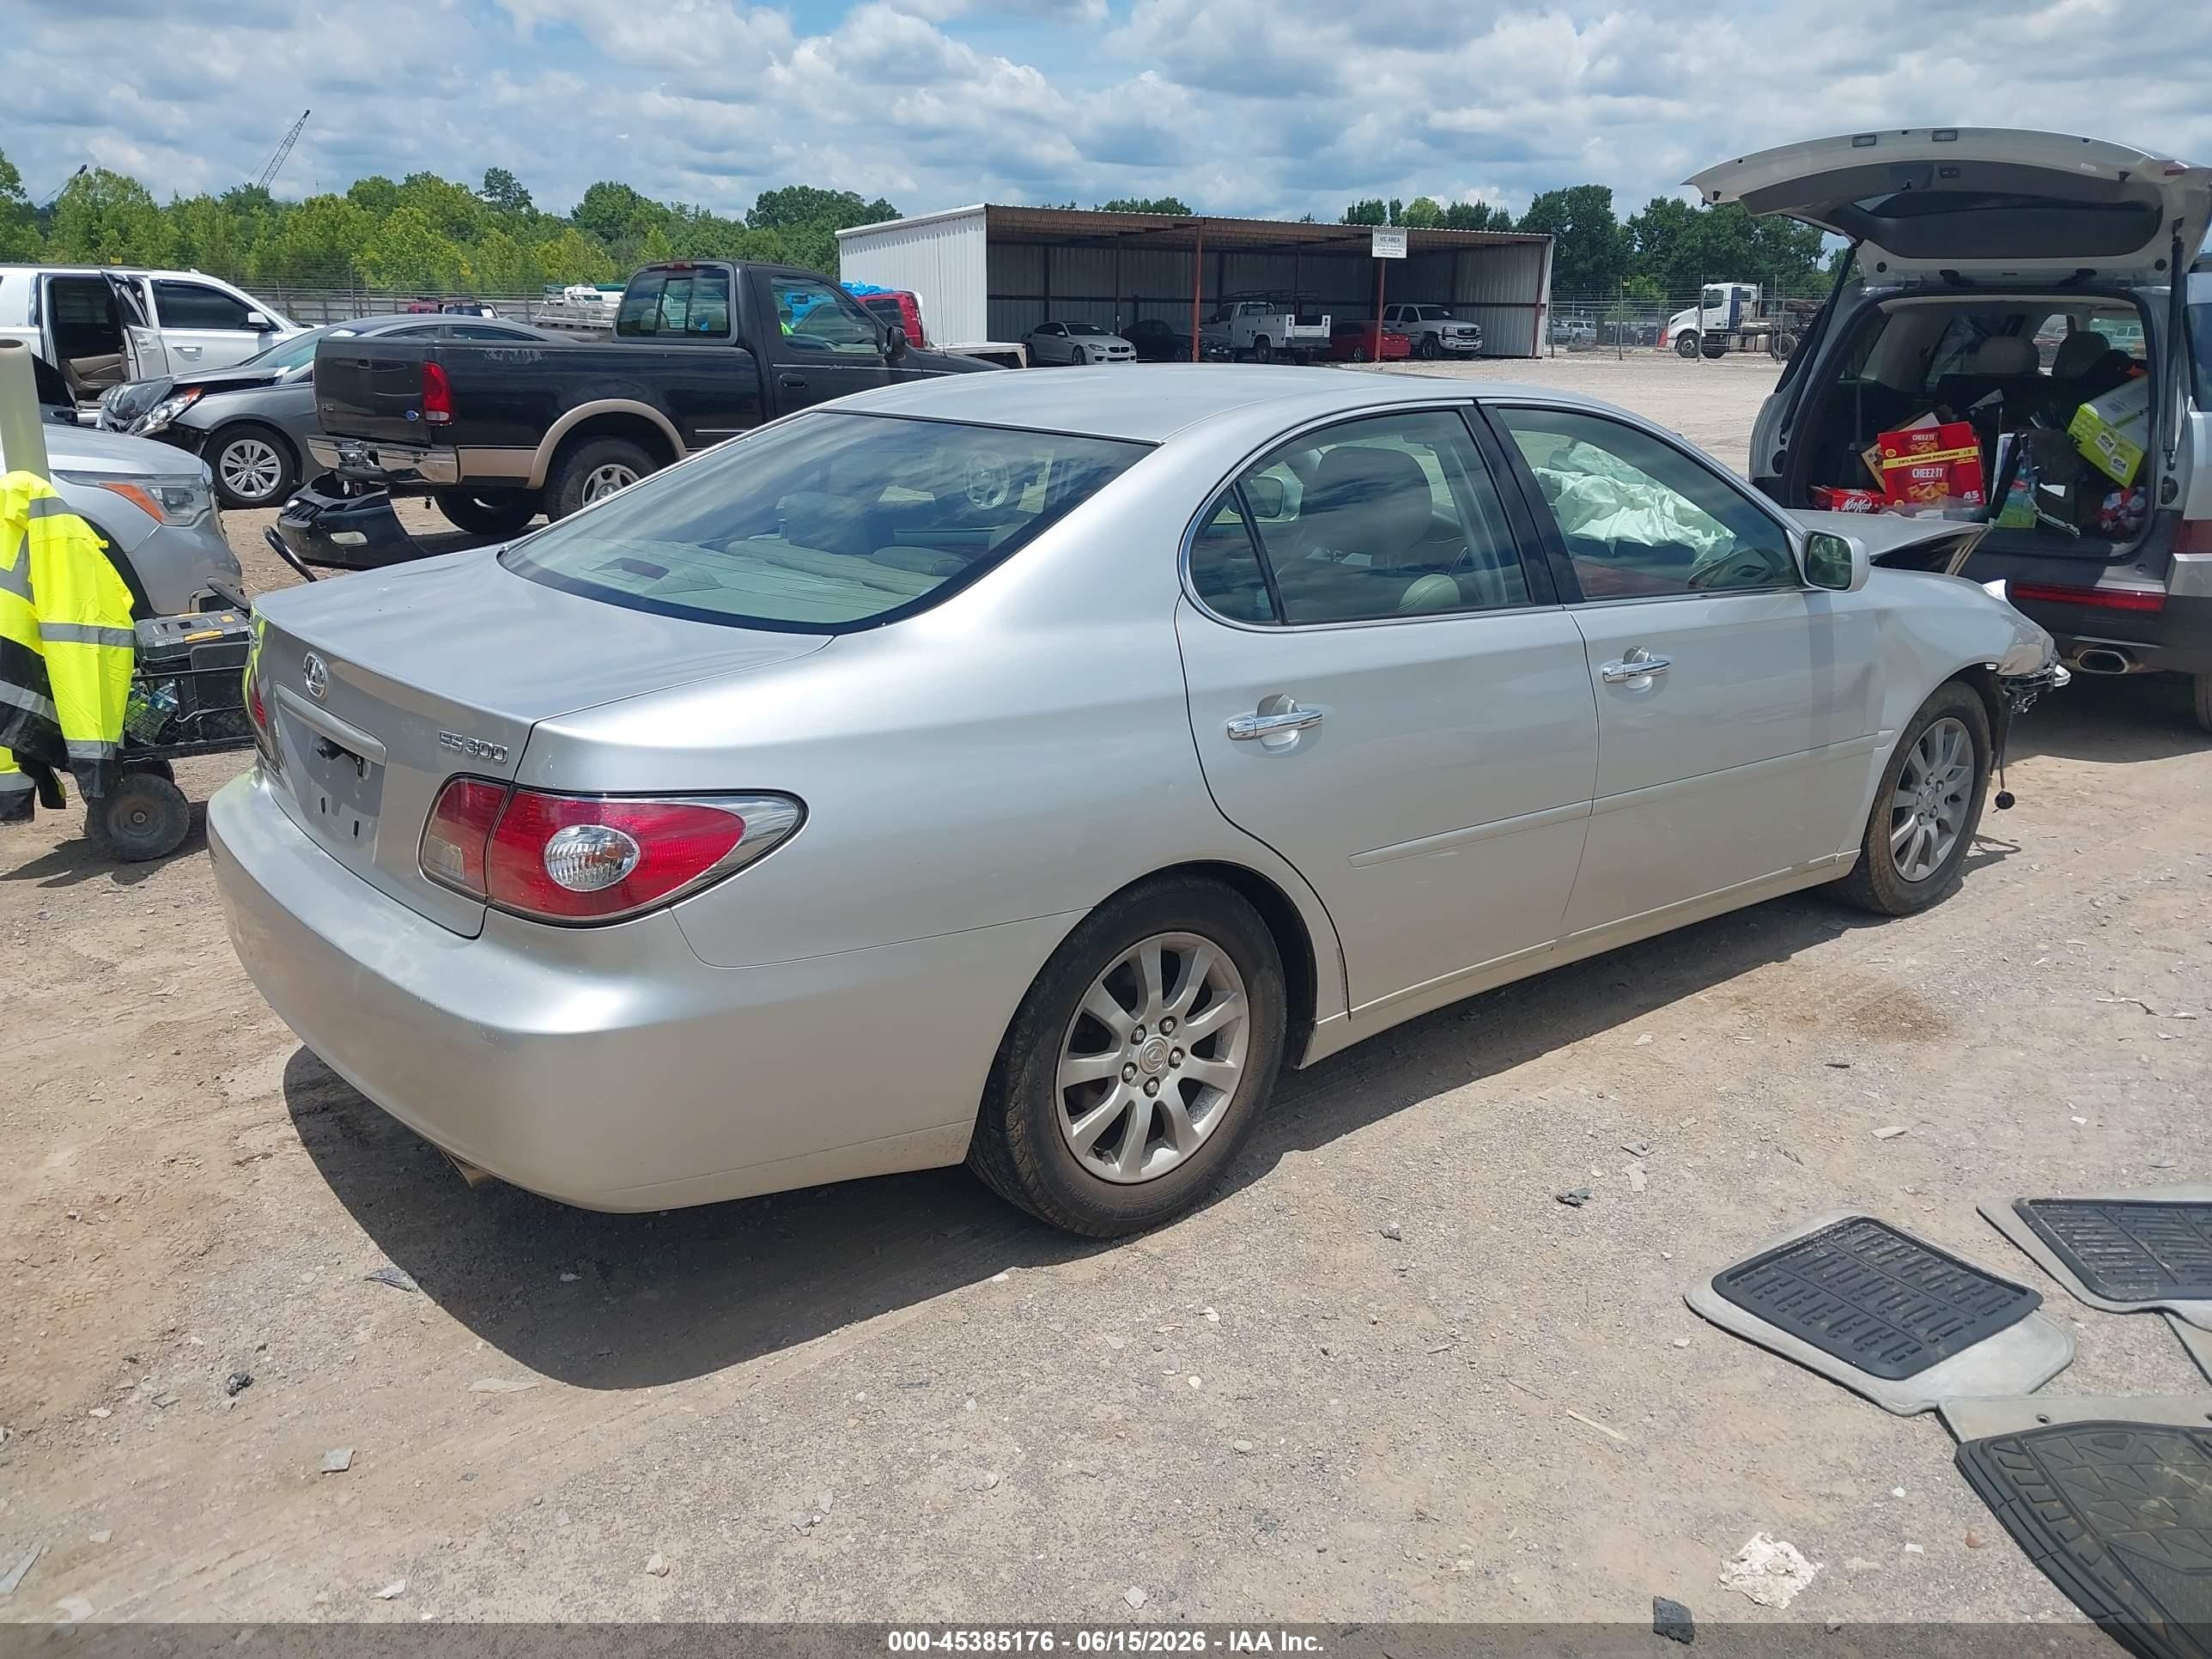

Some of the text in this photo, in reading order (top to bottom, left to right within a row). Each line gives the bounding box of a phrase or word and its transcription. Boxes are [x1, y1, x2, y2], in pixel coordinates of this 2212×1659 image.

[1963, 489, 1979, 500] 45
[439, 730, 509, 763] ES 300
